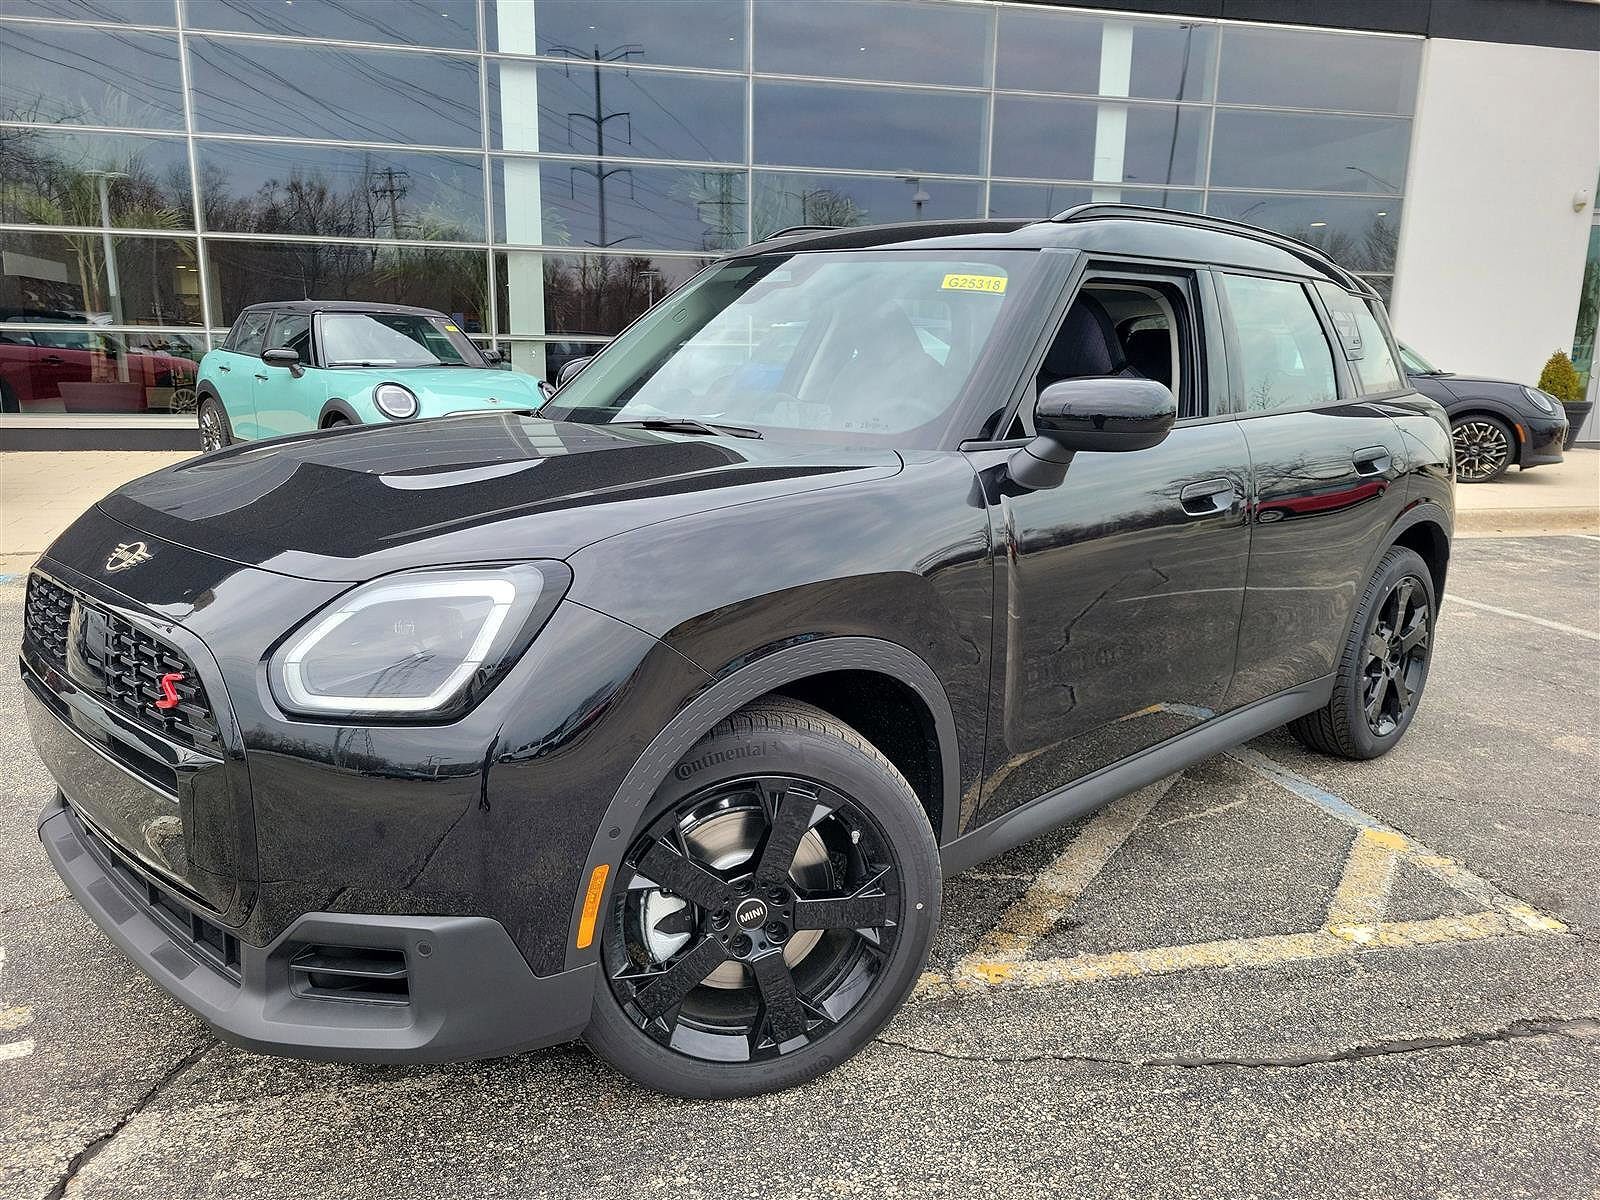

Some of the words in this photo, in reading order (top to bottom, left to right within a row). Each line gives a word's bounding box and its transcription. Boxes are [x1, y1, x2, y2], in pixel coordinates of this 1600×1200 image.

[948, 277, 1001, 291] G25318
[155, 673, 185, 709] S
[674, 741, 767, 781] Continental
[739, 906, 764, 923] MINI
